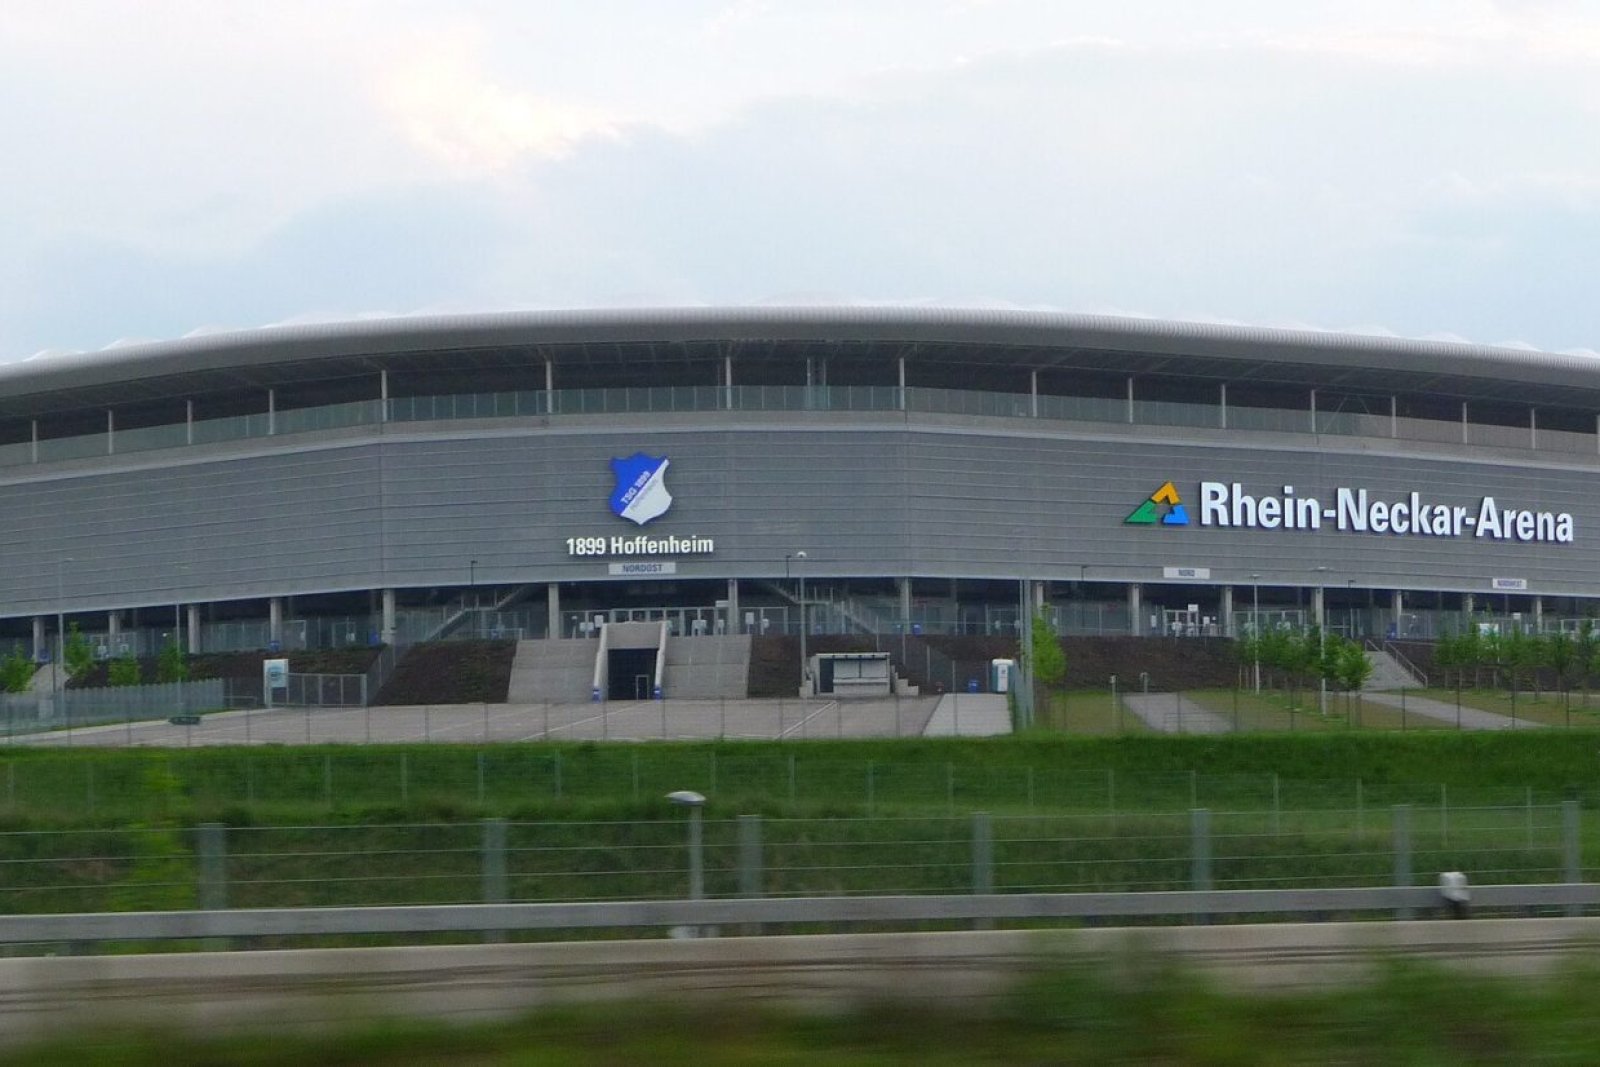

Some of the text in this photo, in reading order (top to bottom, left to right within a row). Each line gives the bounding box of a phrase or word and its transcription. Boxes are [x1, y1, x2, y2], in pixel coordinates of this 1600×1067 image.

[620, 486, 637, 504] TSG
[1200, 482, 1574, 542] Rhein-Neckar-Arena
[566, 535, 714, 555] 1899 Hoffenheim
[623, 564, 664, 573] NORDOST
